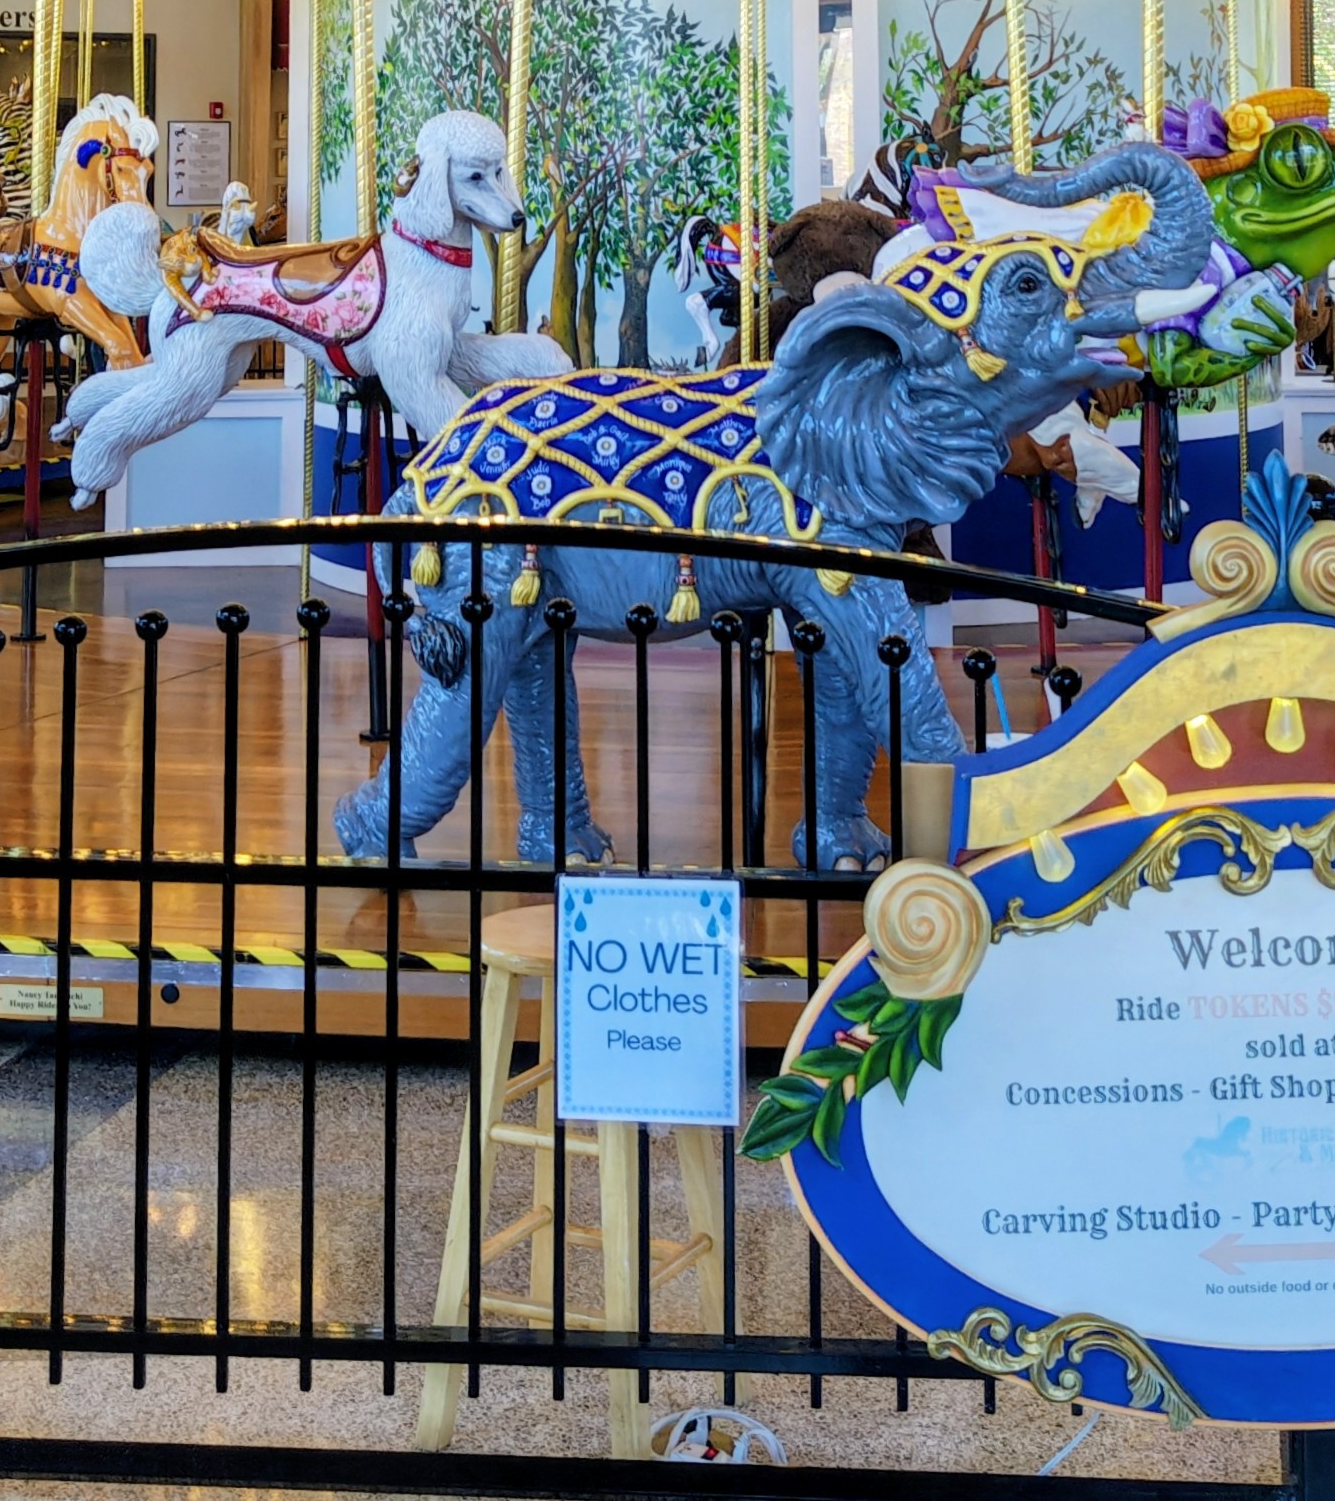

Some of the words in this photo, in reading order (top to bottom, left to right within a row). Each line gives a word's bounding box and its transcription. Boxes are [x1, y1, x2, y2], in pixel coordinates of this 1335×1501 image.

[568, 939, 627, 973] NO
[640, 941, 726, 975] WET
[587, 983, 708, 1015] Clothes
[1116, 996, 1181, 1022] Ride
[1188, 992, 1309, 1020] TOKENS
[607, 1029, 682, 1051] Please
[1245, 1034, 1306, 1059] sold
[1006, 1077, 1184, 1106] Concessions
[1209, 1073, 1264, 1101] Gift
[982, 1205, 1109, 1240] Carving
[1117, 1202, 1221, 1232] Studio
[1205, 1283, 1225, 1295] No
[1227, 1281, 1278, 1295] outside
[1281, 1280, 1311, 1293] food
[1314, 1281, 1329, 1291] or
